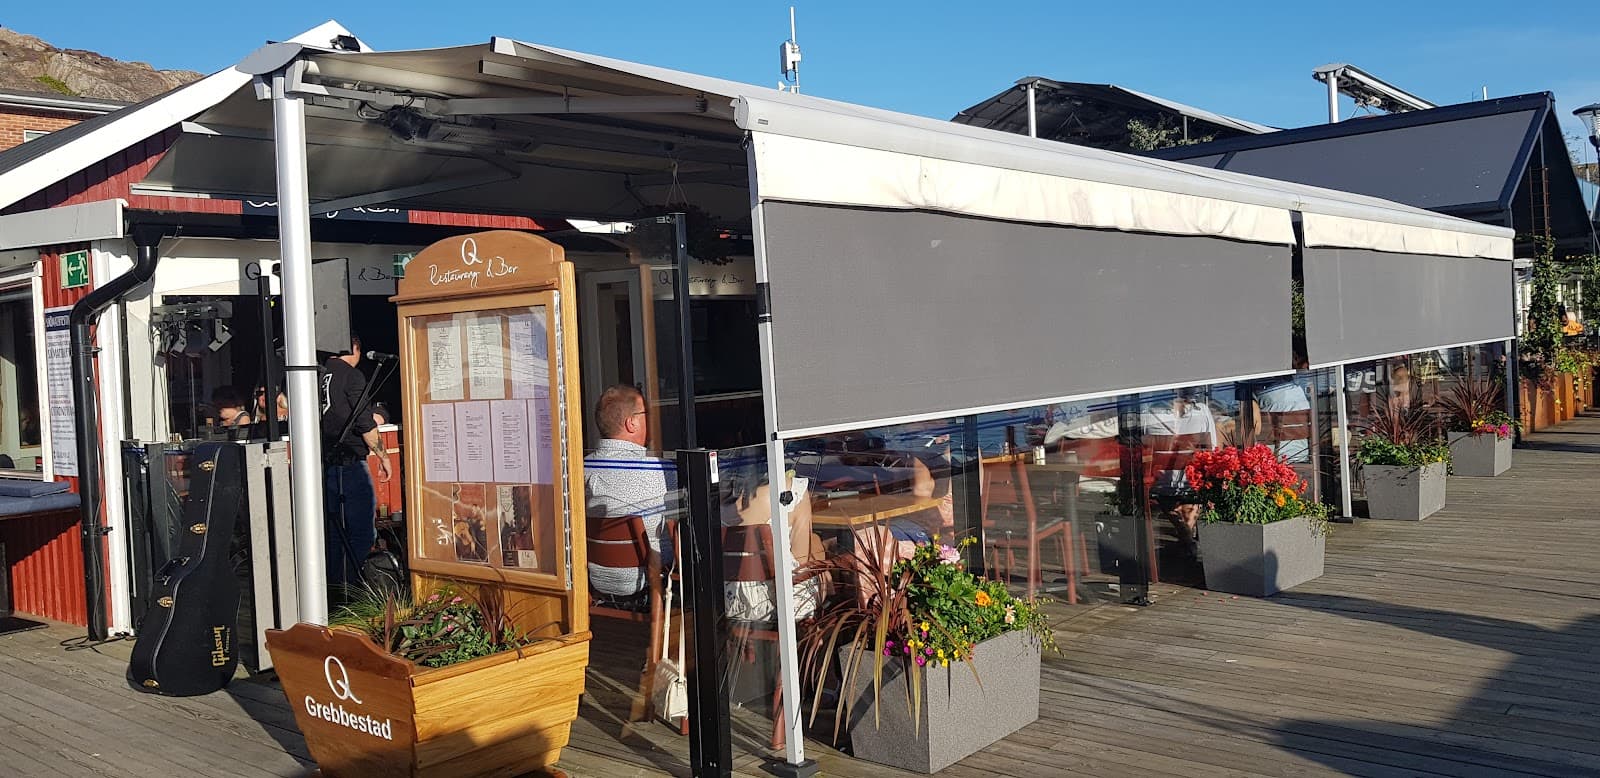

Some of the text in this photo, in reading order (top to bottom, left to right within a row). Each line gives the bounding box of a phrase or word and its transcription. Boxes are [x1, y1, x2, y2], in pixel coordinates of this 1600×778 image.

[461, 237, 483, 266] Q
[428, 256, 519, 289] Restaurang & Bar
[212, 626, 229, 667] Gibson
[324, 655, 363, 705] Q
[304, 695, 393, 741] Grebbestad
